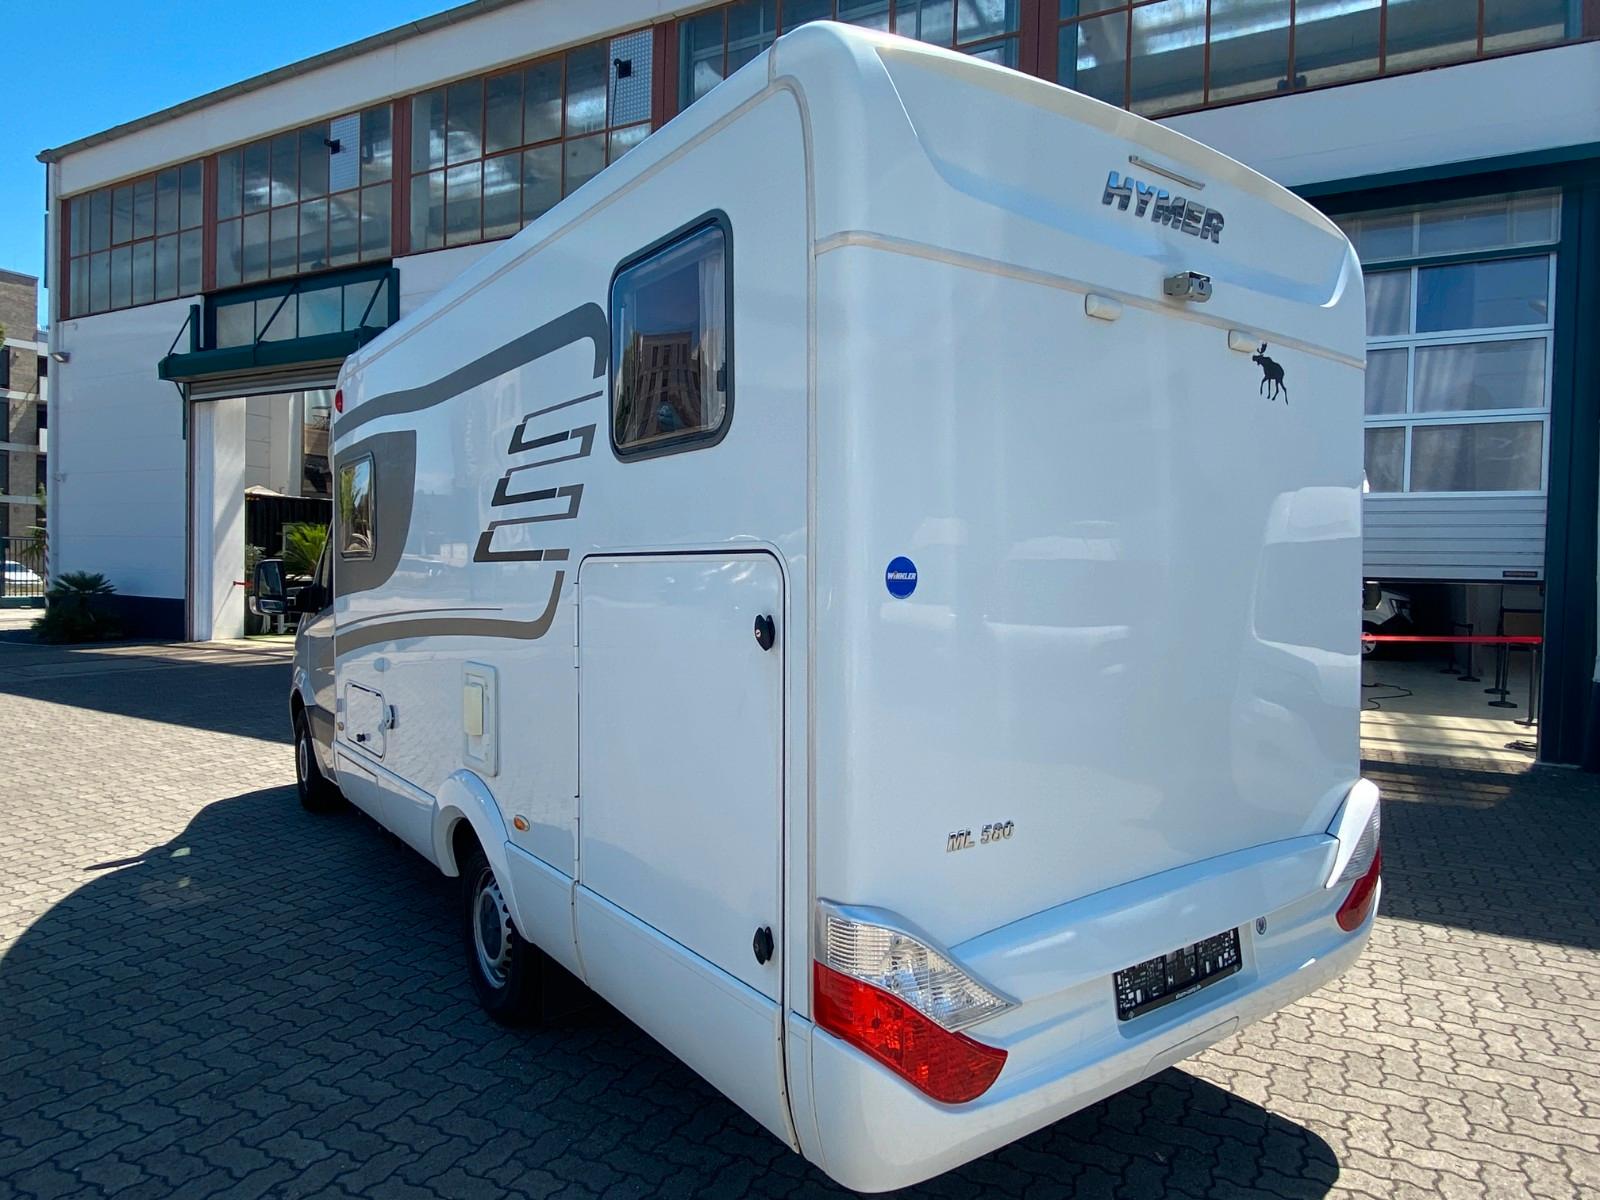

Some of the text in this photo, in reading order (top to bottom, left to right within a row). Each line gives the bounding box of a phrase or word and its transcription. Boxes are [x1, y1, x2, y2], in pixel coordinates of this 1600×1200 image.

[1101, 169, 1225, 244] HYMER
[946, 820, 1015, 853] ML 580
